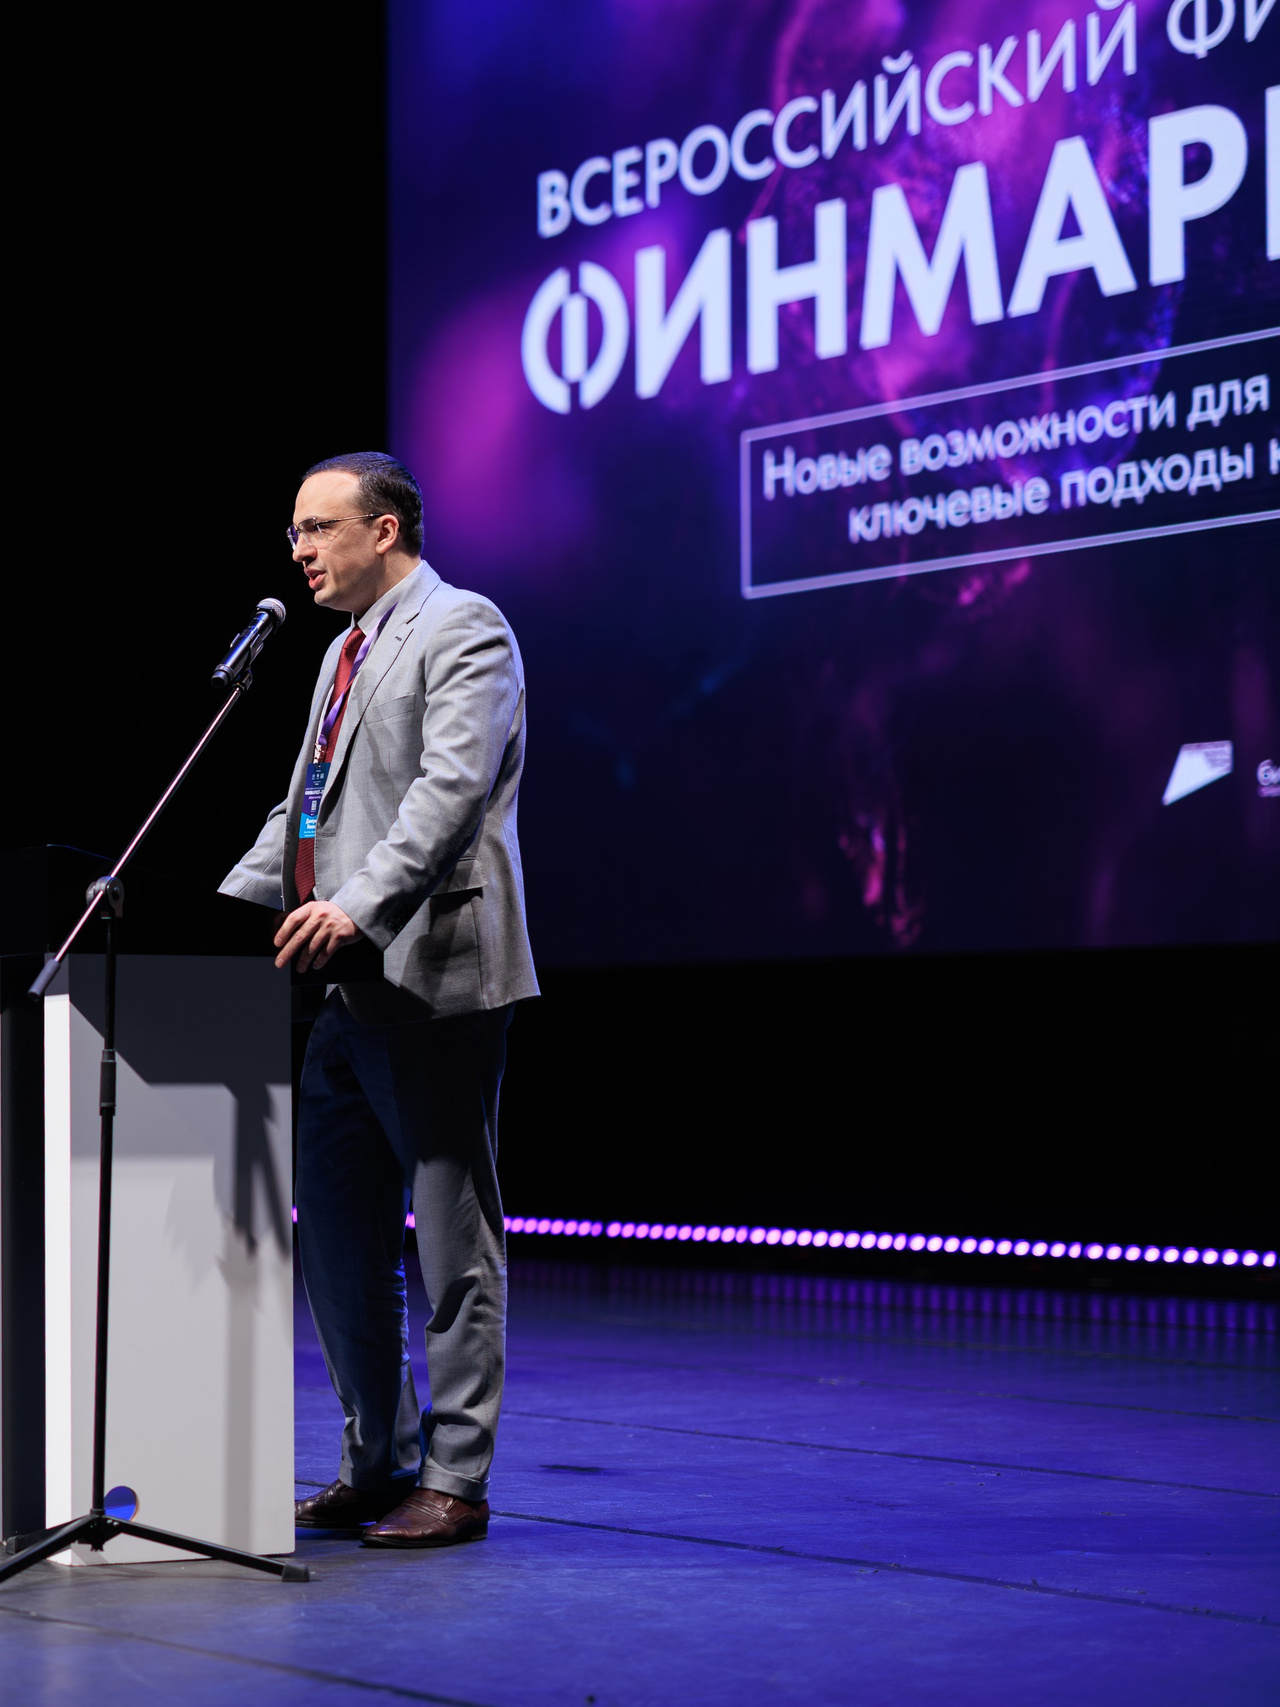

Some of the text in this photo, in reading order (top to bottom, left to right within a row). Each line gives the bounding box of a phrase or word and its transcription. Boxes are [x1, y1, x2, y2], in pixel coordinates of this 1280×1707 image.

[536, 0, 1138, 238] ВСЕРОССИЙСКИЙ
[521, 85, 1280, 414] ФИНМАР
[763, 373, 1269, 501] Новые возможности для
[848, 476, 1050, 544] ключевые
[1060, 441, 1254, 508] подходы
